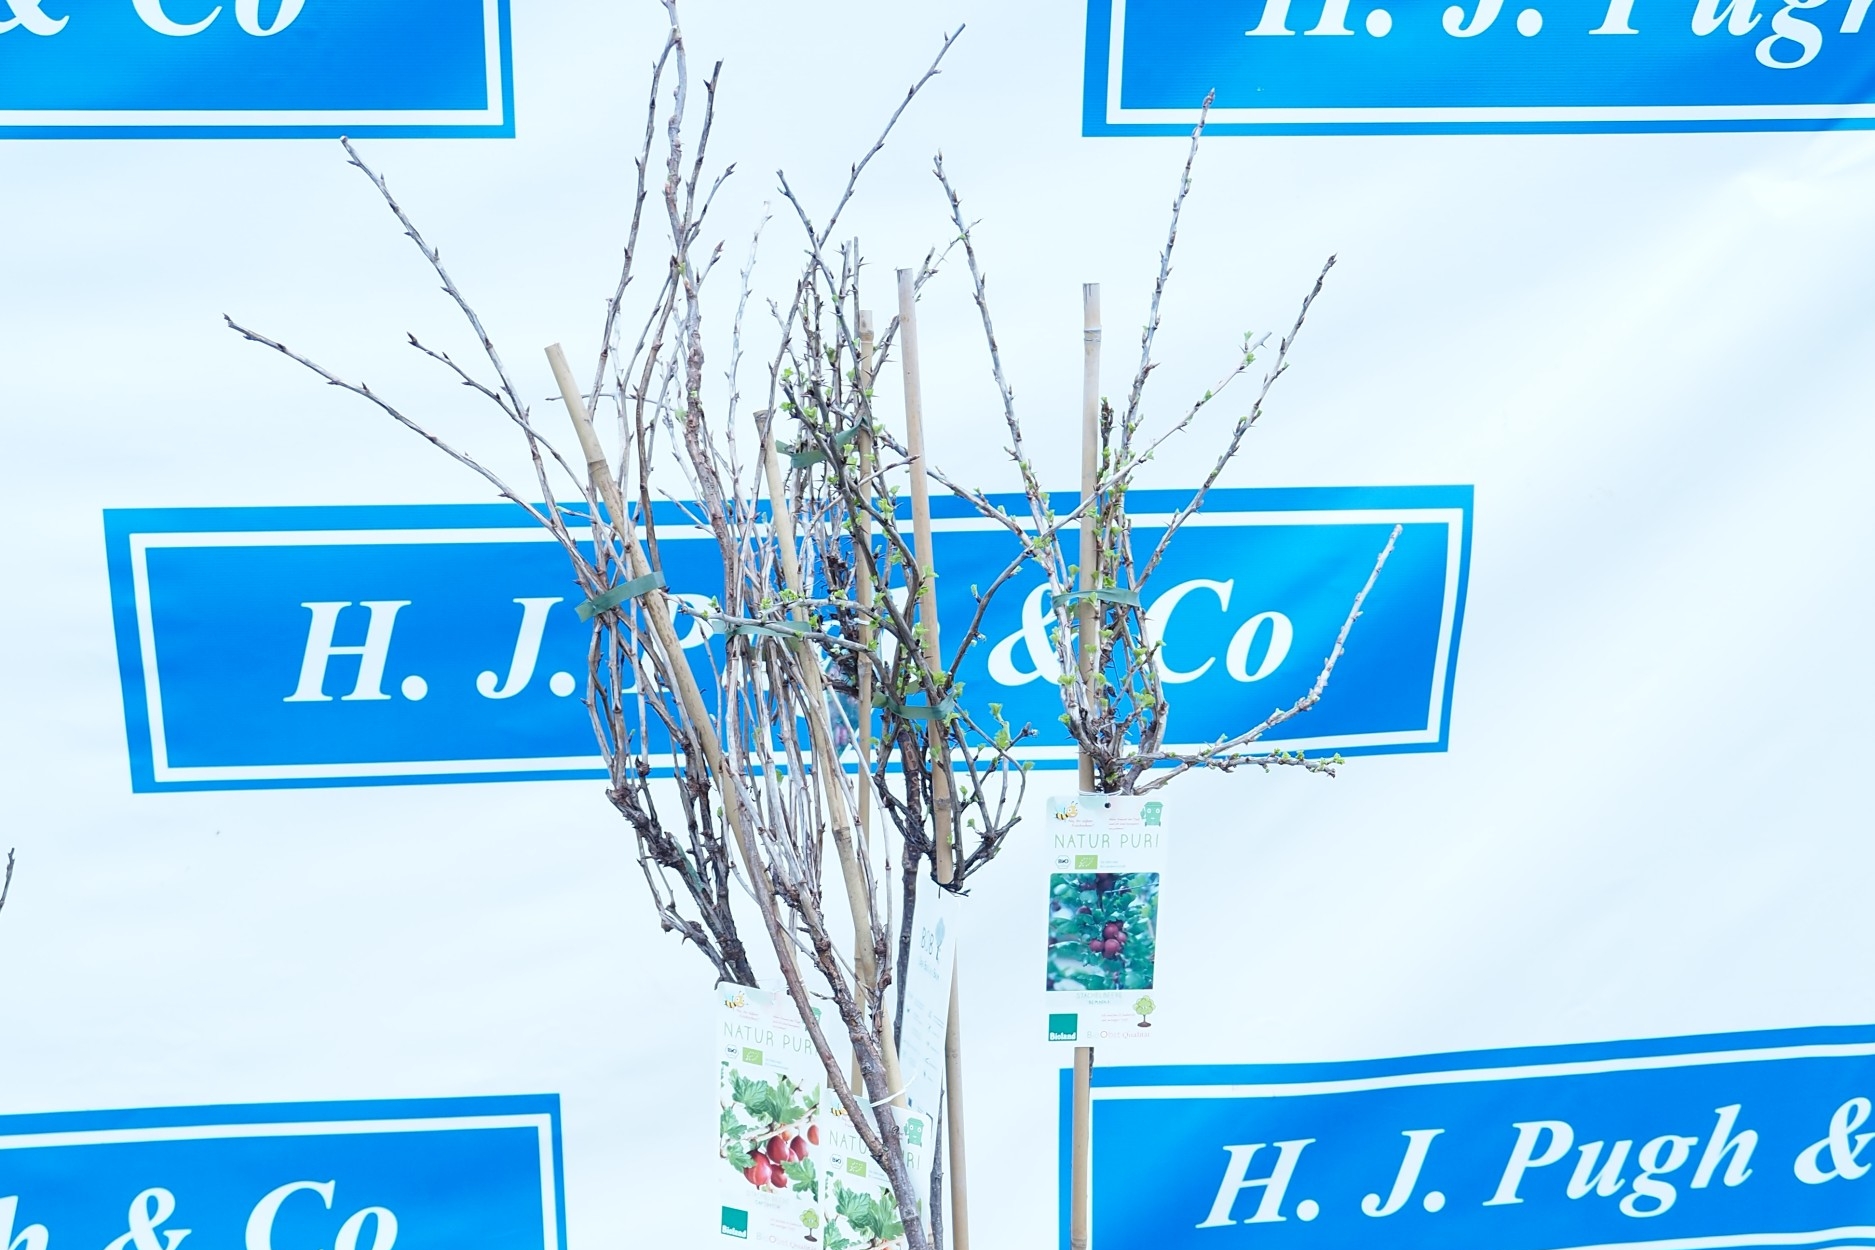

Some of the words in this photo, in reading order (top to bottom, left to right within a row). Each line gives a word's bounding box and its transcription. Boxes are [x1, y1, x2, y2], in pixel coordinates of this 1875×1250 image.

[283, 600, 428, 702] H.
[476, 597, 577, 699] J.
[1141, 578, 1294, 684] Co
[1054, 833, 1110, 848] NATUR
[724, 1021, 774, 1047] NATUR
[783, 1034, 818, 1056] PUR
[829, 1130, 868, 1154] NATU
[1196, 1138, 1320, 1229] H.
[1361, 1128, 1446, 1218] J.
[1482, 1104, 1760, 1219] Pugh
[1794, 1096, 1875, 1185] &
